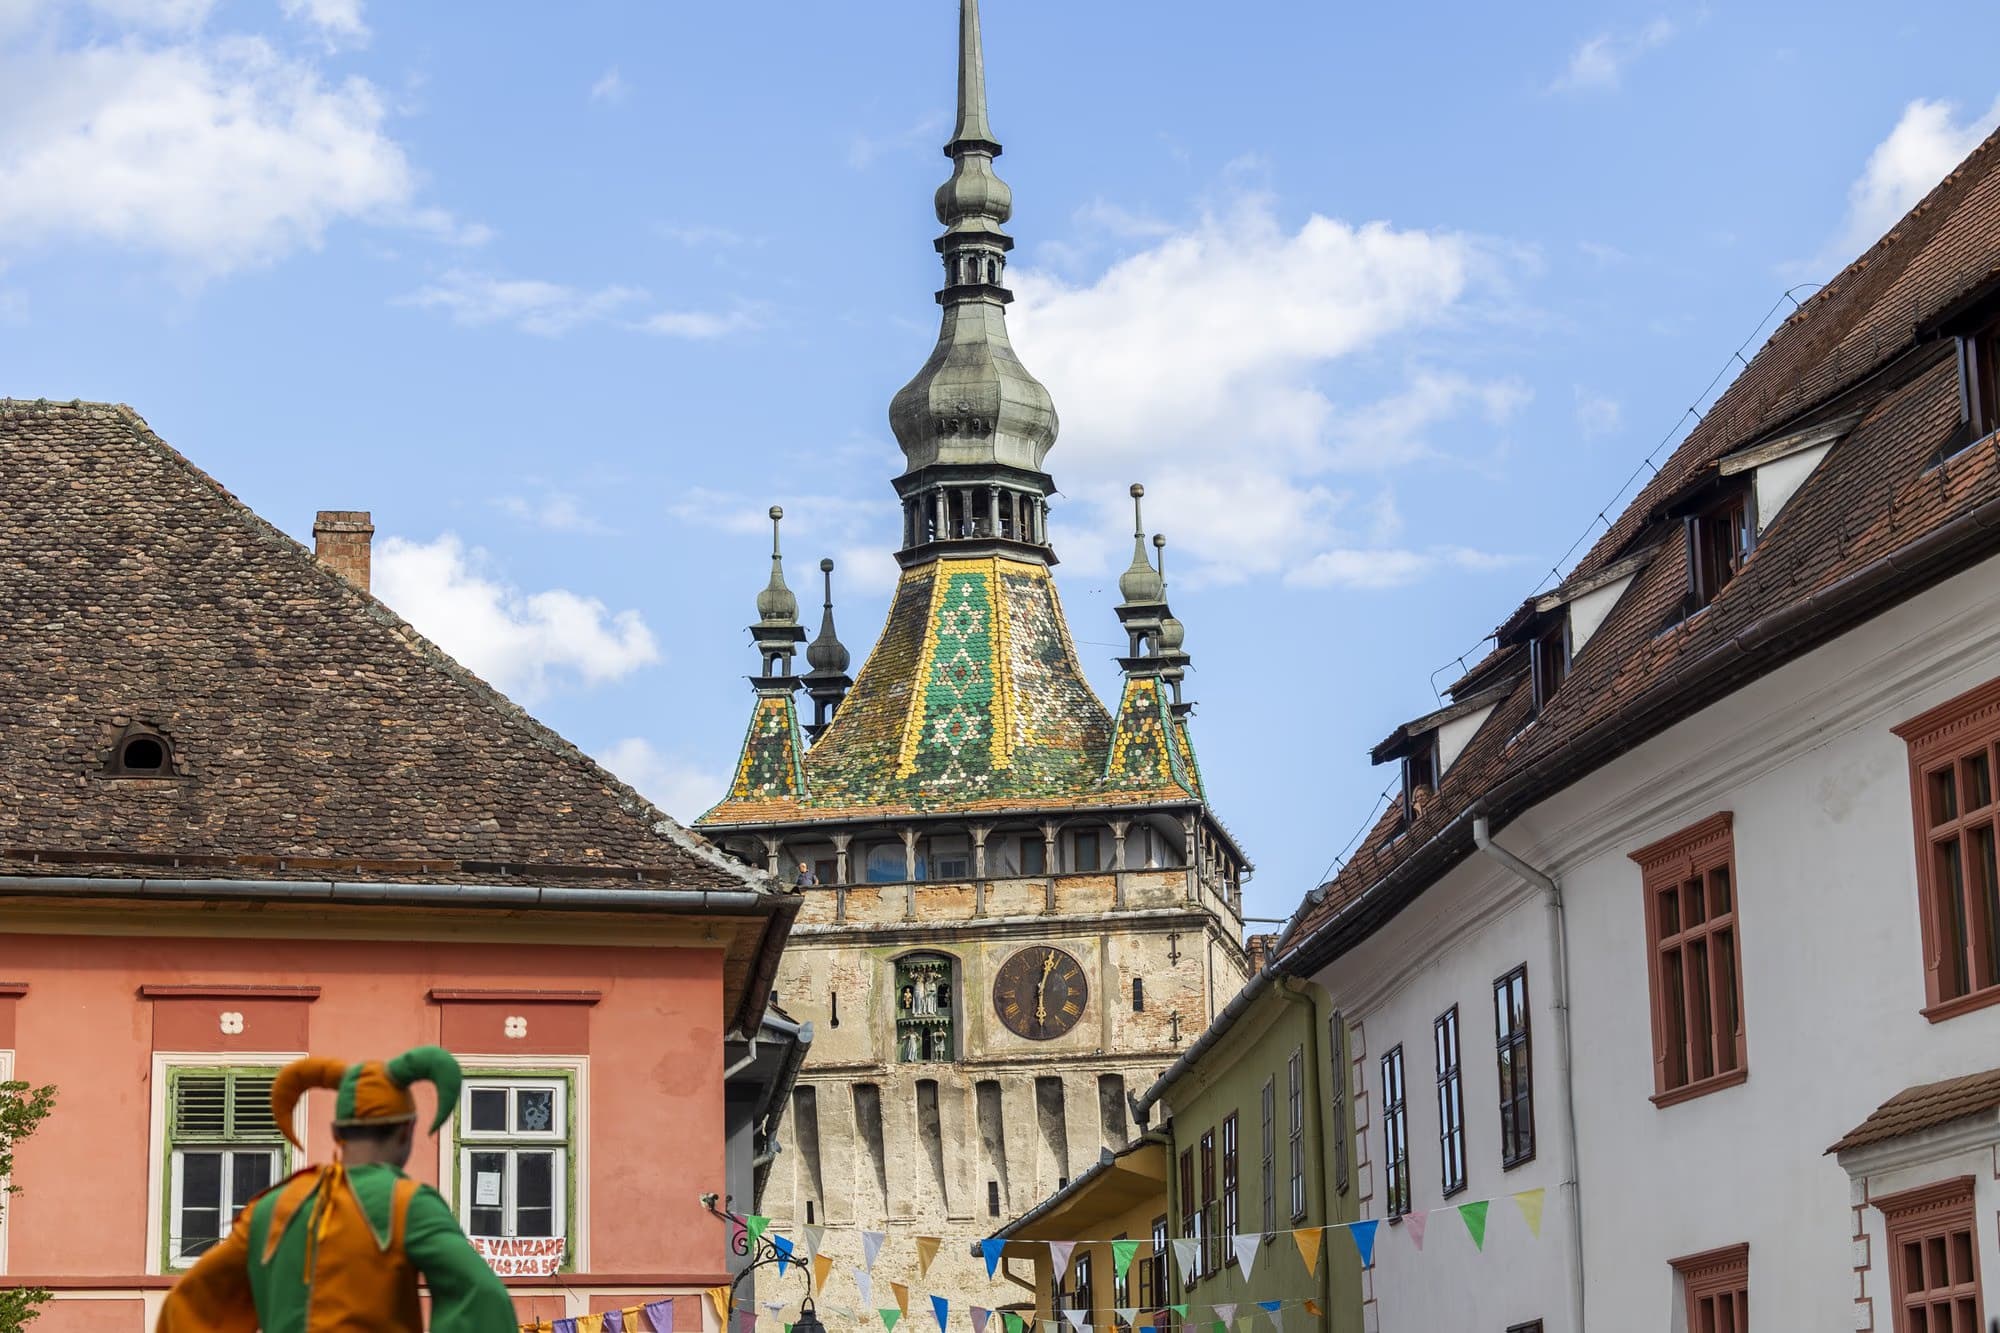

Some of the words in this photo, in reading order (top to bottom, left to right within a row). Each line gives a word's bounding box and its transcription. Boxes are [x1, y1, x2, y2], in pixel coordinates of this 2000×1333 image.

[488, 1238, 564, 1256] VANZARE
[484, 1258, 512, 1274] 748
[515, 1259, 539, 1274] 248
